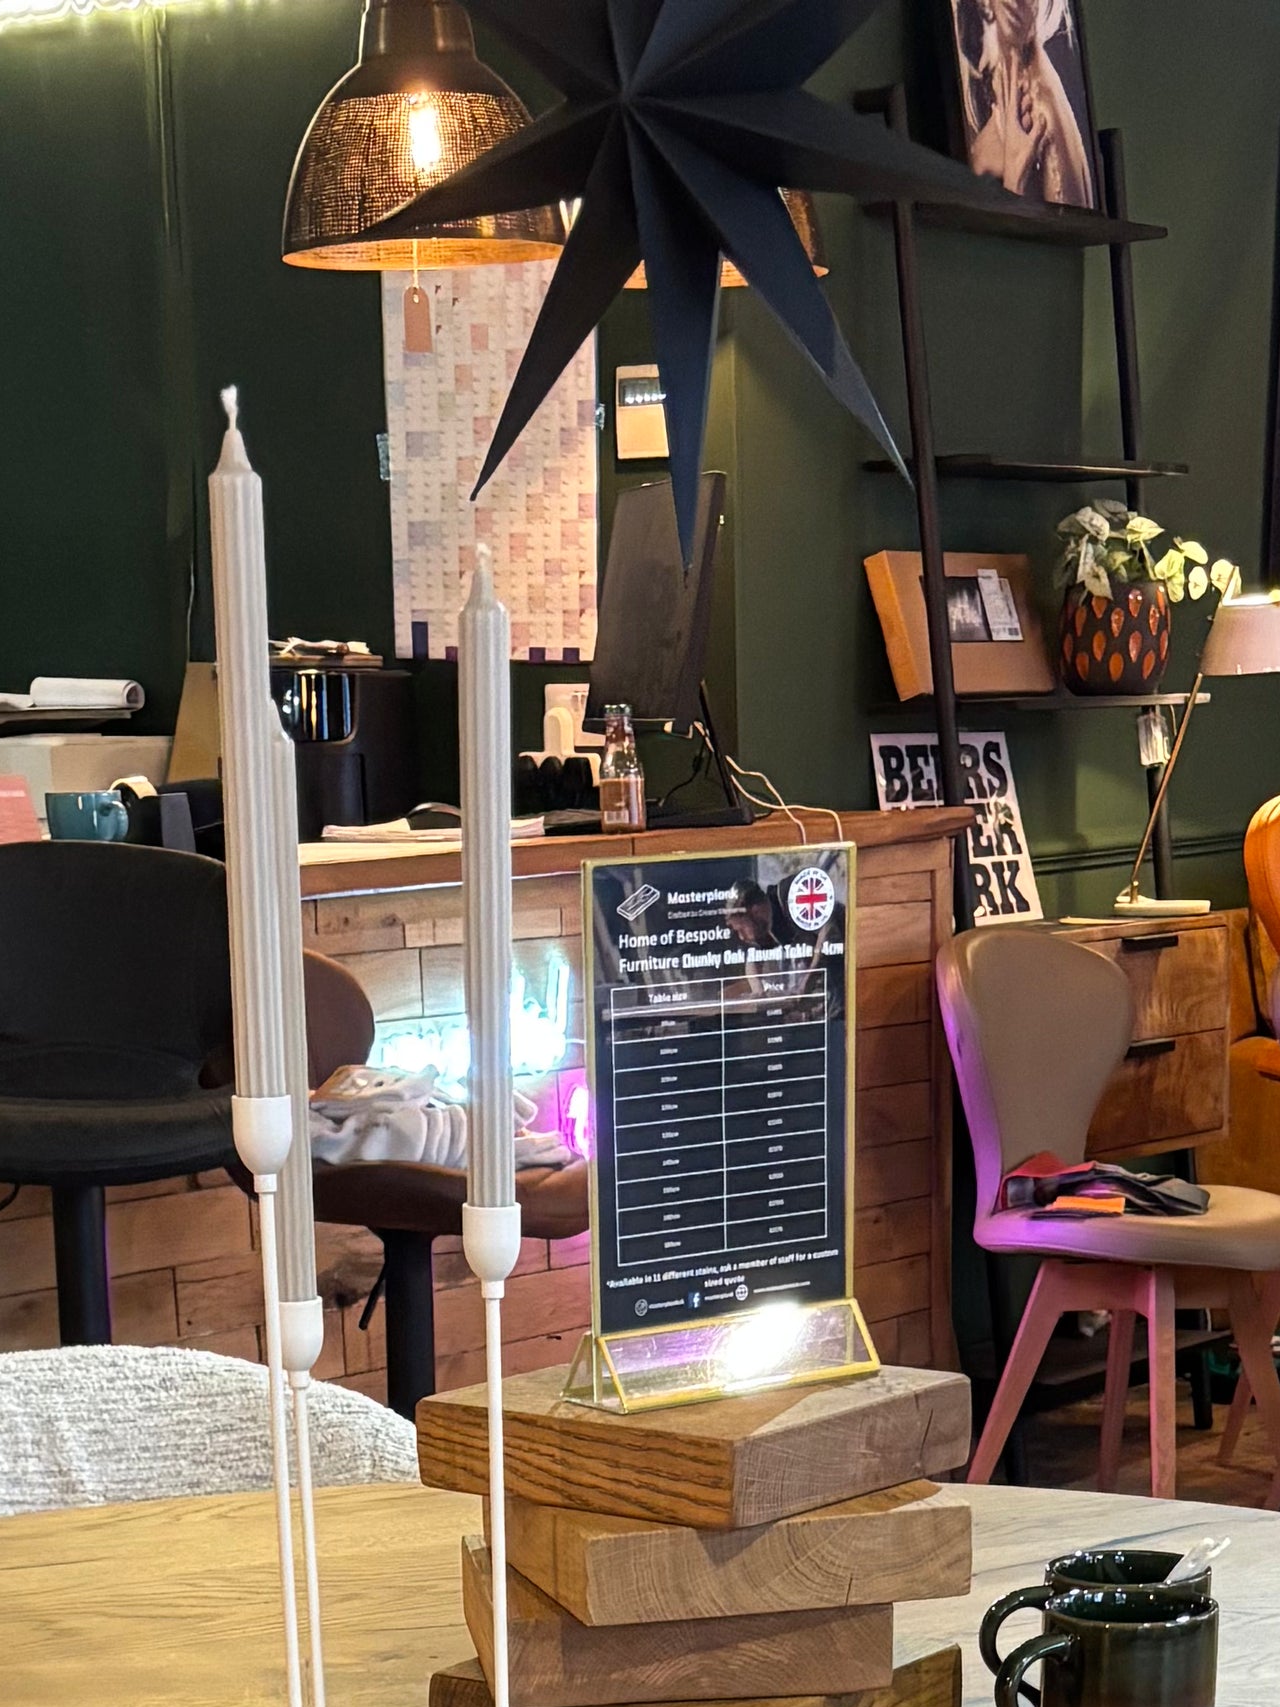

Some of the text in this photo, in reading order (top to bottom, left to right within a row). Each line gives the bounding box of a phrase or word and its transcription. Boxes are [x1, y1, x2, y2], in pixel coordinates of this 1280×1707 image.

[667, 887, 738, 904] Masterplank
[619, 925, 731, 949] Home of Bespoke
[619, 955, 680, 973] Furniture
[682, 951, 722, 969] Chunky
[723, 949, 745, 964] Oak
[648, 993, 671, 1003] Table
[662, 1269, 694, 1281] different
